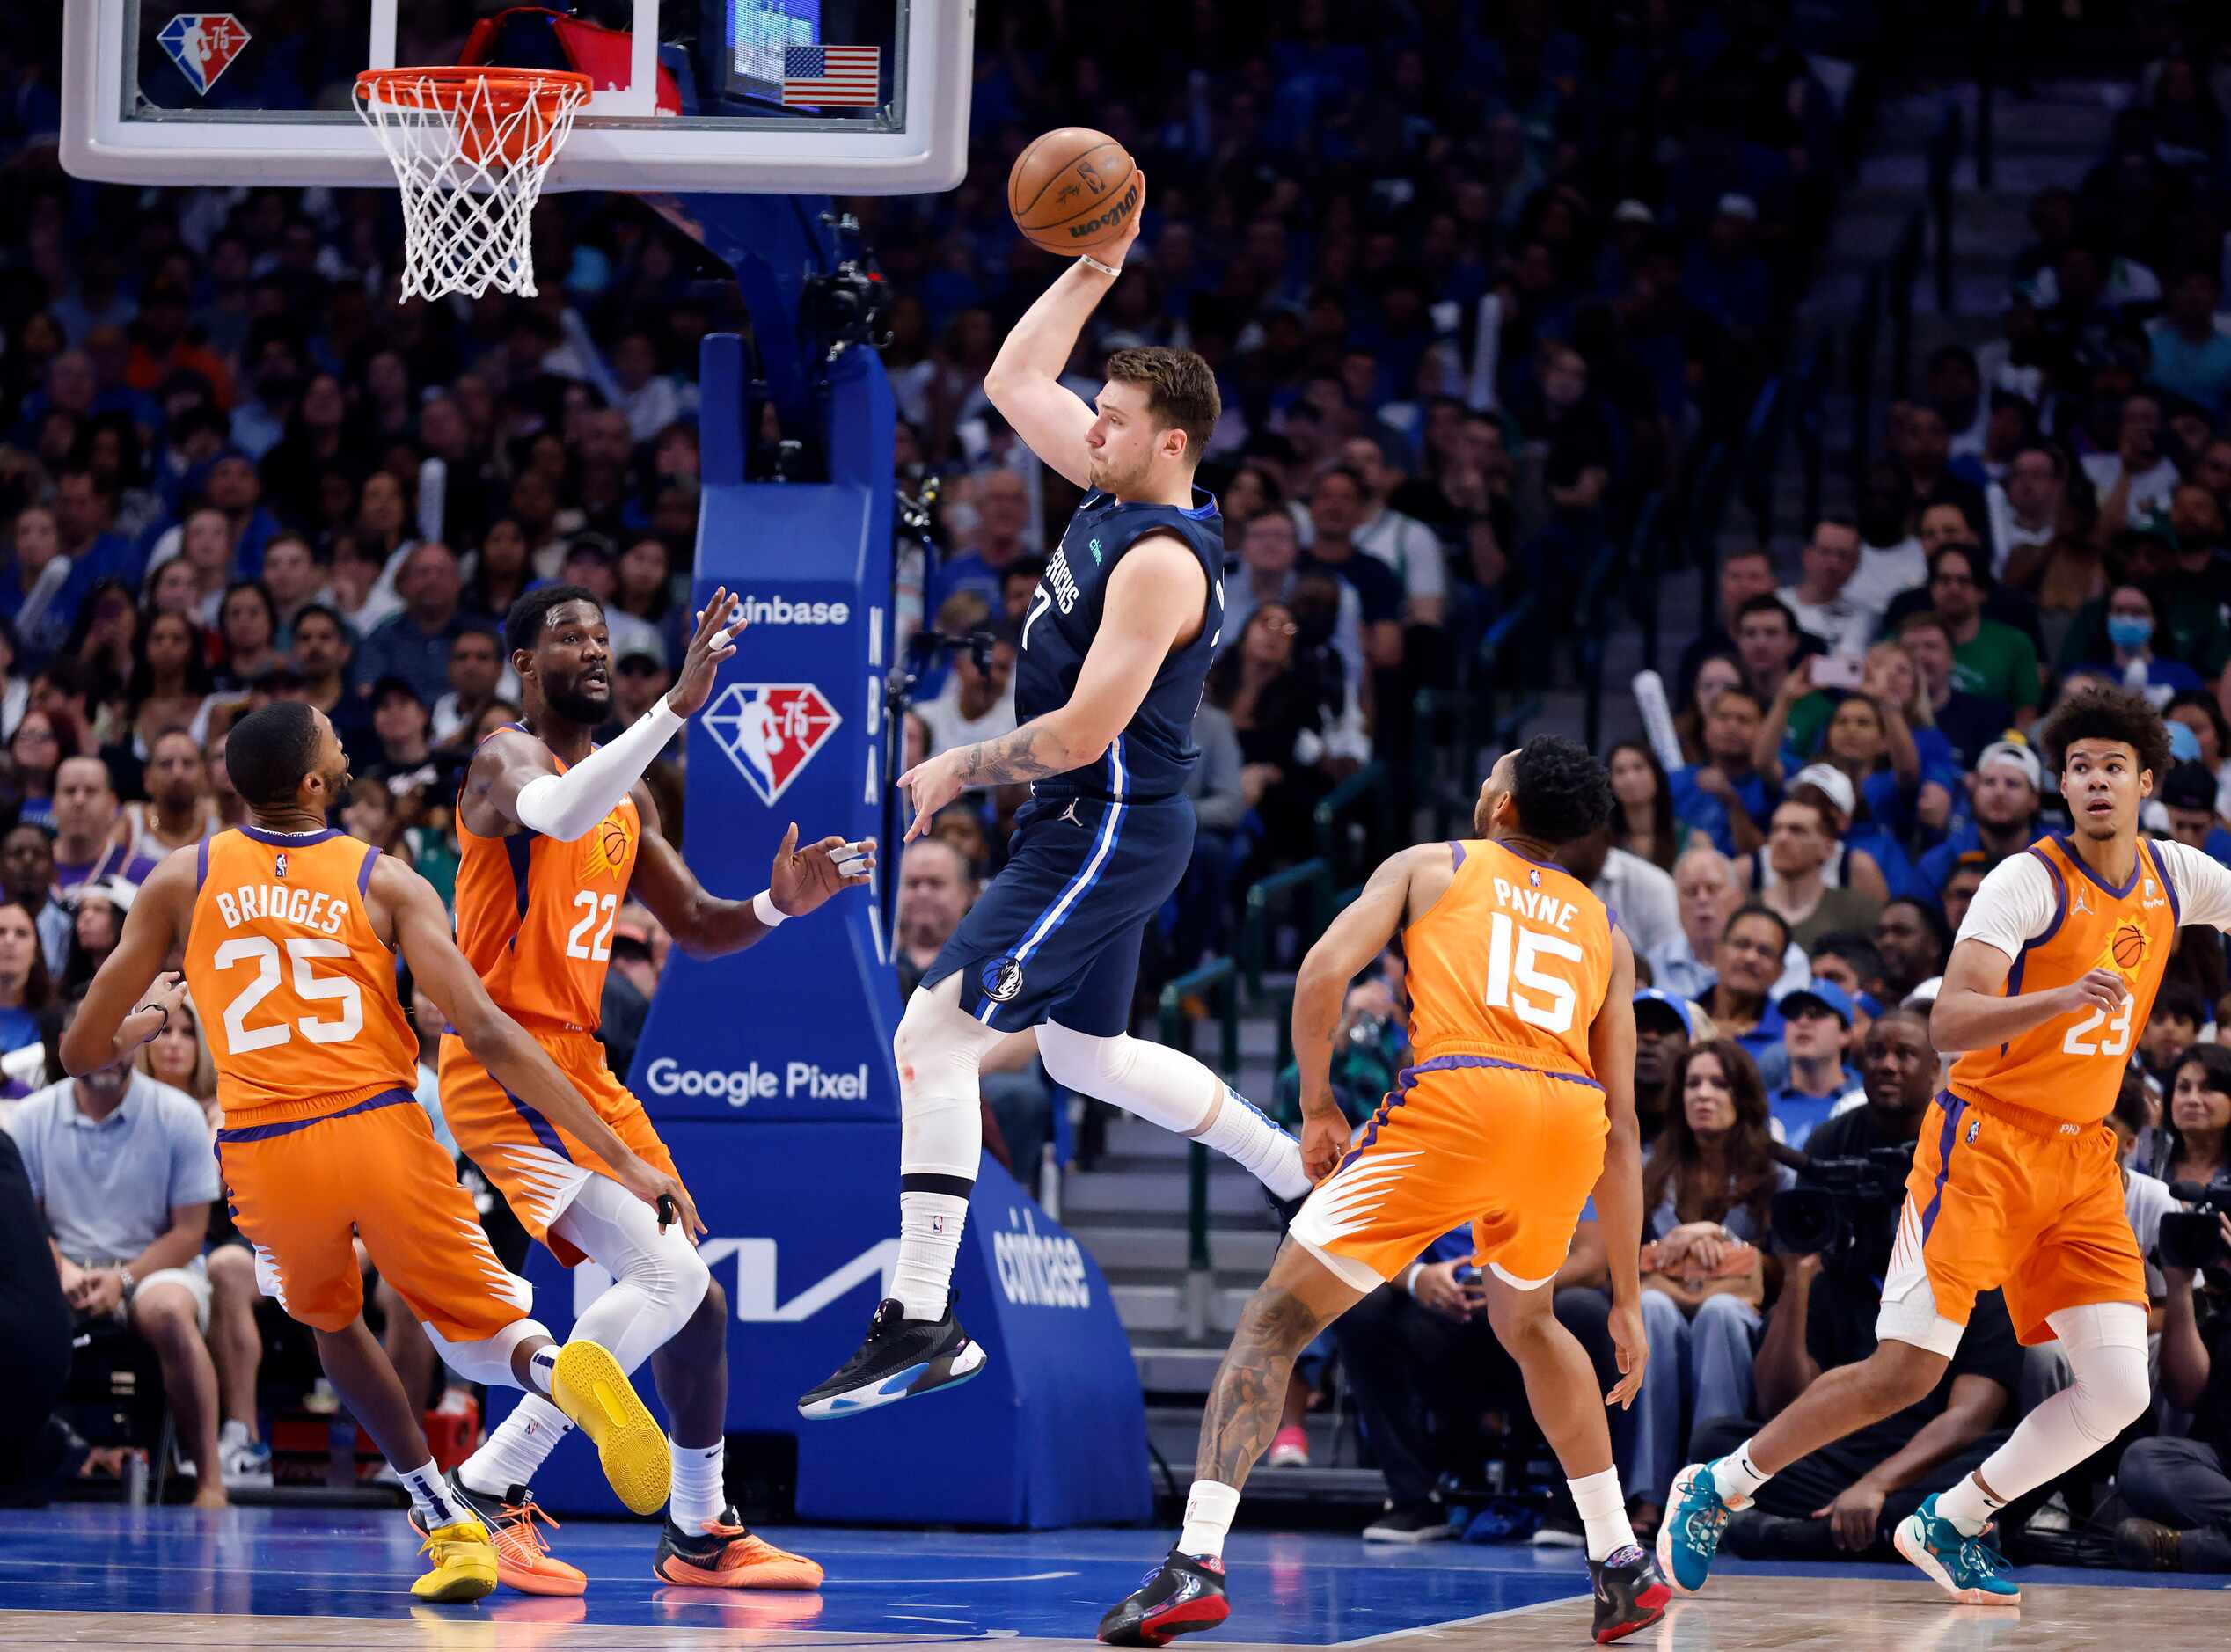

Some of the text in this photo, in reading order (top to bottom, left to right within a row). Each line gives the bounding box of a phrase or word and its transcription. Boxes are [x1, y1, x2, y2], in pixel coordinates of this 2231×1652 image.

[726, 594, 850, 625] oinbase
[1044, 545, 1081, 616] ERICKS
[780, 700, 811, 739] 75
[216, 883, 349, 935] BRIDGES
[566, 889, 618, 962] 22
[1492, 876, 1580, 933] PAYNE
[214, 935, 363, 1056] 25
[1484, 910, 1584, 1034] 15
[2062, 992, 2135, 1056] 23
[646, 1057, 869, 1108] Google Pixel
